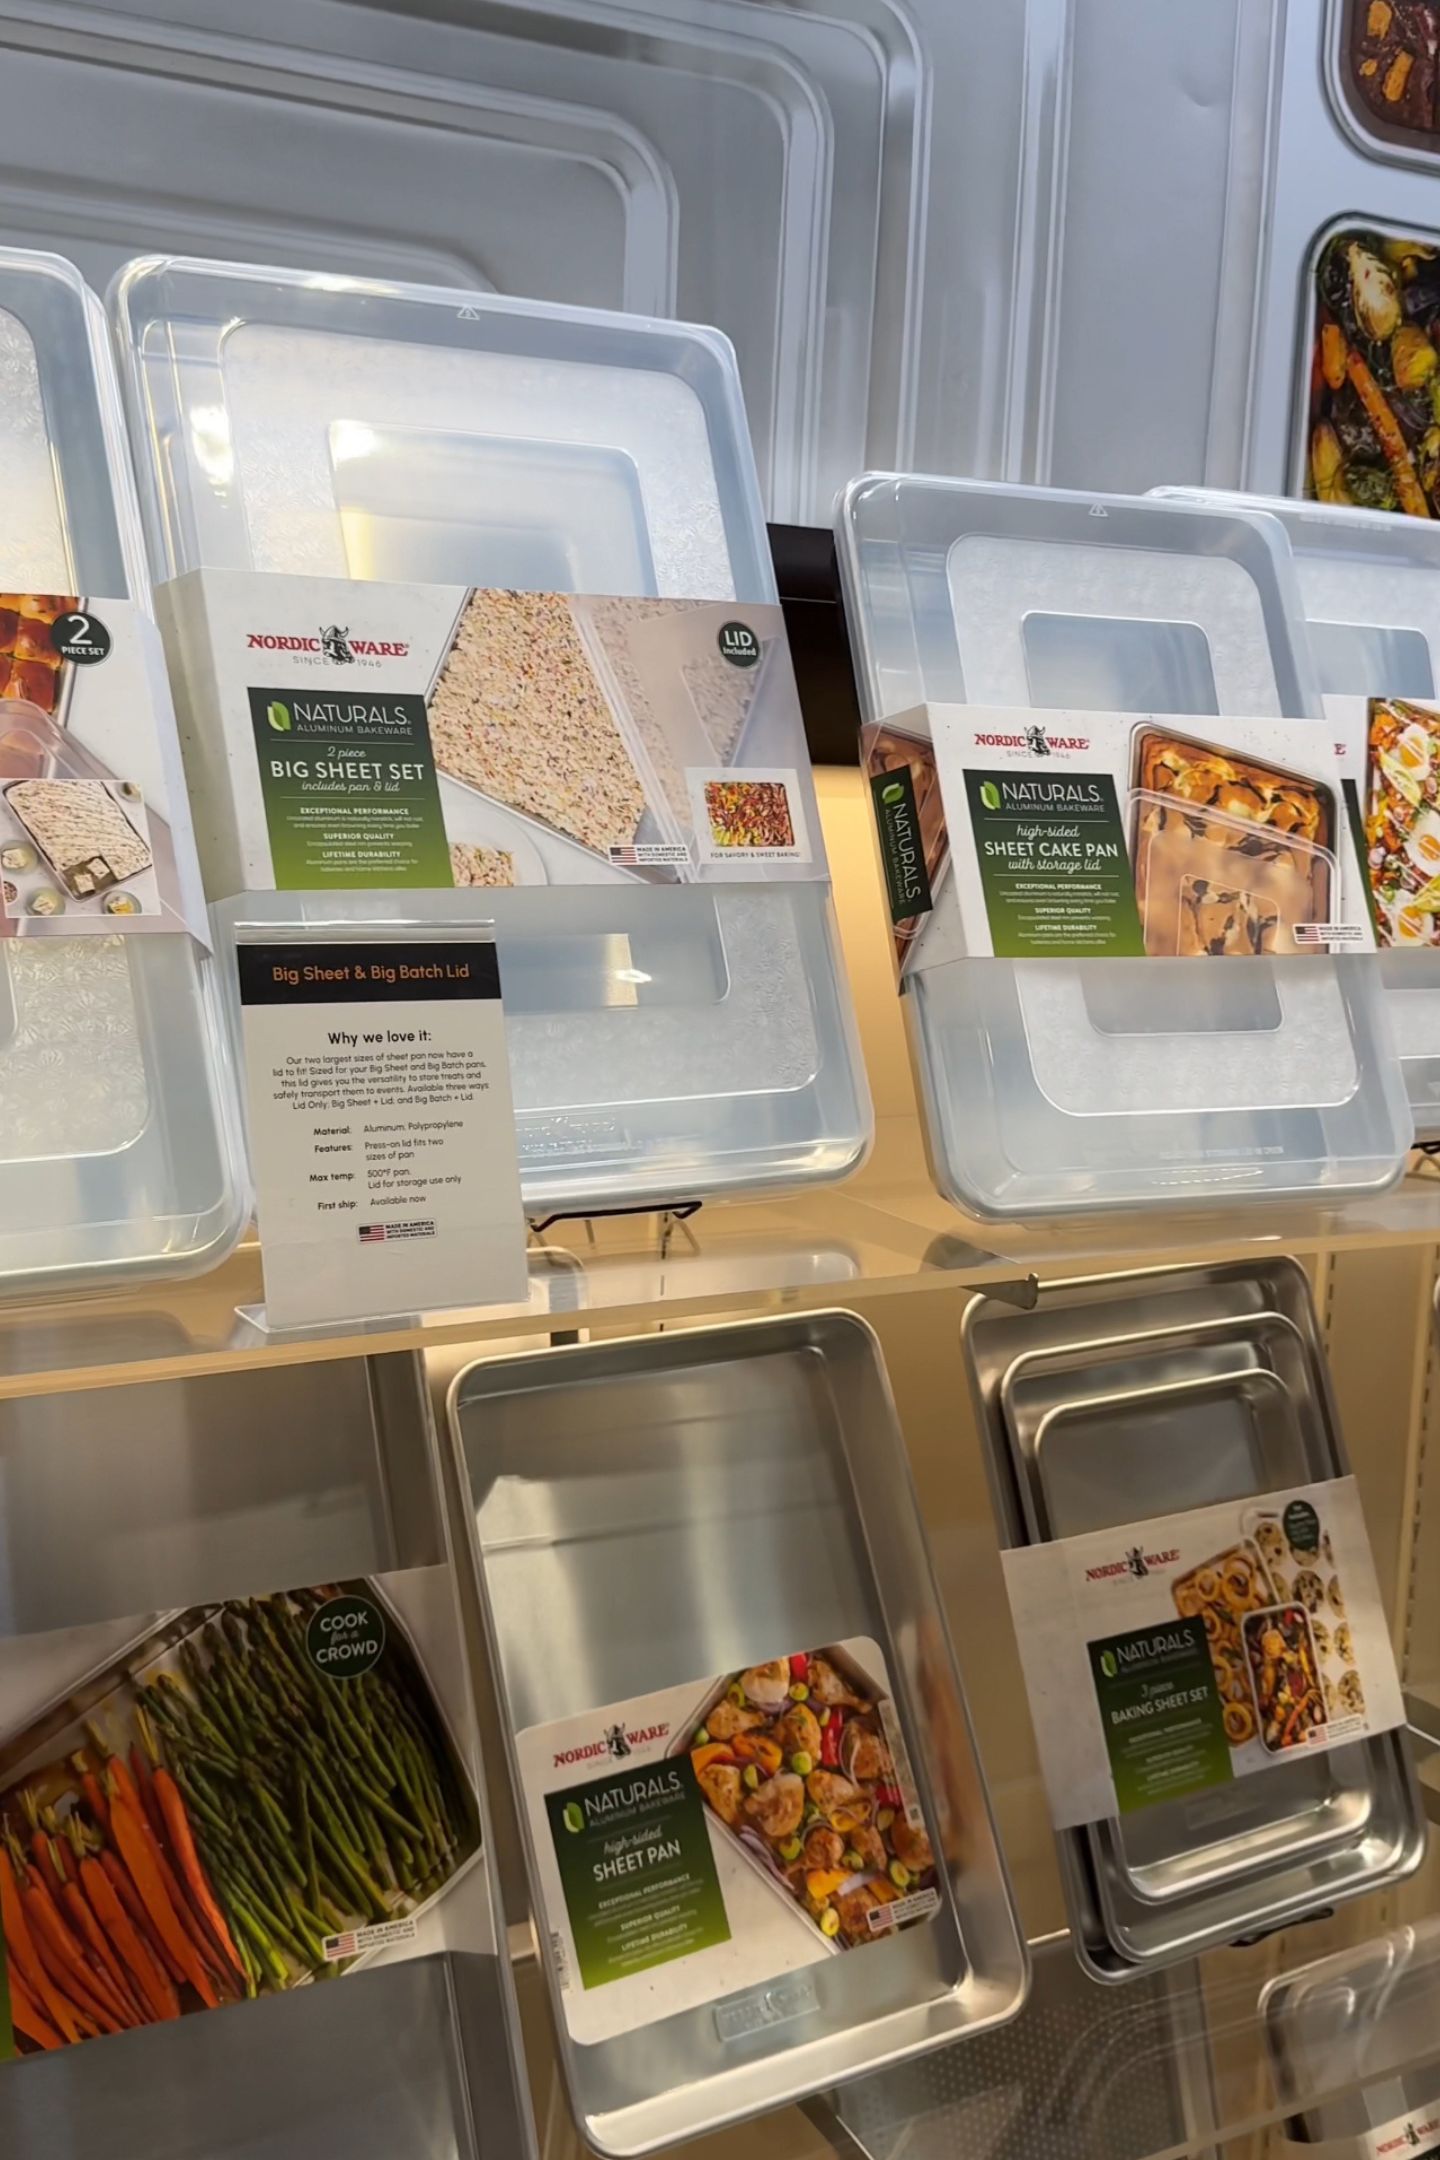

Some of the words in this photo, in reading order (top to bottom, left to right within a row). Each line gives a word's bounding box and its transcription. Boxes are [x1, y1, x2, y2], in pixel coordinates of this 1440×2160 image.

[67, 615, 92, 644] 2
[247, 634, 321, 652] NORDIC
[348, 640, 408, 656] WARE
[724, 630, 752, 646] LID
[61, 646, 87, 655] PIECE
[88, 647, 105, 655] SET
[292, 655, 330, 666] SINCE
[356, 658, 382, 668] 1946
[293, 702, 409, 725] NATURALS
[296, 723, 353, 734] ALUMINUM
[356, 724, 413, 736] BAKEWARE
[974, 734, 1027, 747] NORDIC
[1045, 737, 1089, 750] WARE
[327, 746, 336, 758] 2
[337, 748, 366, 760] piece
[1006, 750, 1033, 758] SINCE
[270, 761, 310, 778] BIG
[315, 761, 382, 779] SHEET
[389, 763, 425, 780] SET
[301, 781, 347, 792] includes
[347, 782, 370, 794] pan
[373, 781, 382, 791] &
[384, 781, 400, 792] lid
[1002, 782, 1101, 803] NATURALS
[300, 807, 352, 815] EXCEPTIONAL
[353, 808, 409, 816] PERFORMANCE
[1005, 802, 1054, 812] ALUMINUM
[1056, 804, 1105, 813] BAKEWARE
[363, 833, 394, 841] QUALITY
[1016, 825, 1081, 840] high-sided
[322, 851, 356, 859] LIFETIME
[357, 851, 401, 859] DURABILITY
[892, 803, 922, 899] NATURALS
[984, 841, 1034, 856] SHEET
[1039, 842, 1082, 857] CAKE
[1085, 843, 1119, 857] PAN
[1008, 858, 1036, 870] with
[1036, 859, 1083, 875] storage
[1084, 859, 1102, 871] lid
[1066, 907, 1091, 915] QUALITY
[272, 966, 299, 985] Big
[303, 965, 350, 981] Sheet
[354, 965, 366, 979] &
[371, 964, 396, 983] Big
[400, 964, 443, 979] Batch
[446, 964, 470, 978] Lid
[328, 1030, 359, 1048] Why
[362, 1034, 383, 1043] we
[387, 1030, 416, 1043] love
[418, 1029, 432, 1042] it:
[286, 1056, 302, 1065] Our
[304, 1056, 321, 1064] two
[322, 1055, 352, 1066] largest
[353, 1055, 374, 1063] sizes
[375, 1052, 384, 1061] of
[386, 1052, 409, 1061] sheet
[410, 1053, 426, 1062] pan
[446, 1051, 466, 1059] have
[272, 1068, 283, 1077] lid
[286, 1068, 295, 1077] to
[309, 1066, 333, 1076] Sized
[335, 1065, 347, 1074] for
[349, 1066, 367, 1075] your
[369, 1064, 383, 1075] Big
[384, 1063, 408, 1072] Sheet
[410, 1062, 426, 1071] and
[427, 1062, 440, 1072] Big
[441, 1061, 465, 1069] Batch
[281, 1080, 296, 1088] this
[298, 1079, 308, 1087] lid
[310, 1079, 333, 1088] gives
[335, 1079, 350, 1087] you
[367, 1075, 406, 1084] versatility
[408, 1074, 418, 1082] to
[419, 1073, 440, 1081] store
[440, 1072, 465, 1080] treats
[465, 1071, 482, 1079] and
[273, 1090, 299, 1100] safely
[301, 1088, 340, 1099] transport
[342, 1088, 365, 1096] them
[366, 1087, 375, 1095] to
[407, 1084, 444, 1093] Available
[292, 1101, 306, 1110] Lid
[331, 1099, 345, 1109] Big
[346, 1098, 371, 1107] Sheet
[397, 1095, 413, 1104] and
[414, 1094, 428, 1105] Big
[429, 1094, 452, 1103] Batch
[313, 1126, 352, 1136] Material:
[408, 1119, 464, 1131] Polypropylene
[314, 1144, 353, 1153] Features:
[364, 1141, 401, 1150] Press-on
[402, 1138, 412, 1148] lid
[413, 1138, 426, 1147] fits
[428, 1138, 444, 1146] two
[366, 1152, 386, 1161] sizes
[388, 1151, 397, 1160] of
[398, 1152, 415, 1161] pan
[309, 1173, 328, 1182] Max
[330, 1172, 355, 1183] temp:
[368, 1180, 381, 1189] Lid
[382, 1179, 395, 1188] for
[396, 1177, 428, 1188] storage
[429, 1177, 444, 1185] use
[445, 1175, 462, 1185] only
[317, 1201, 336, 1211] First
[338, 1200, 358, 1211] ship:
[370, 1196, 408, 1206] Available
[409, 1195, 426, 1203] now
[1085, 1561, 1129, 1581] NORDIC
[320, 1611, 368, 1632] COOK
[316, 1639, 378, 1663] CROWD
[1116, 1629, 1195, 1663] NATURALS
[1111, 1701, 1154, 1724] BAKING
[1154, 1691, 1189, 1712] SHEET
[1189, 1686, 1209, 1702] SET
[553, 1740, 607, 1768] NORDIC
[626, 1724, 670, 1745] WARE
[584, 1771, 681, 1817] NATURALS
[603, 1824, 663, 1856] high-sided
[593, 1849, 645, 1882] SHEET
[647, 1839, 682, 1865] PAN
[643, 1873, 690, 1895] PERFORMANCE
[620, 1914, 653, 1931] SUPERIOR
[654, 1905, 681, 1920] QUALITY
